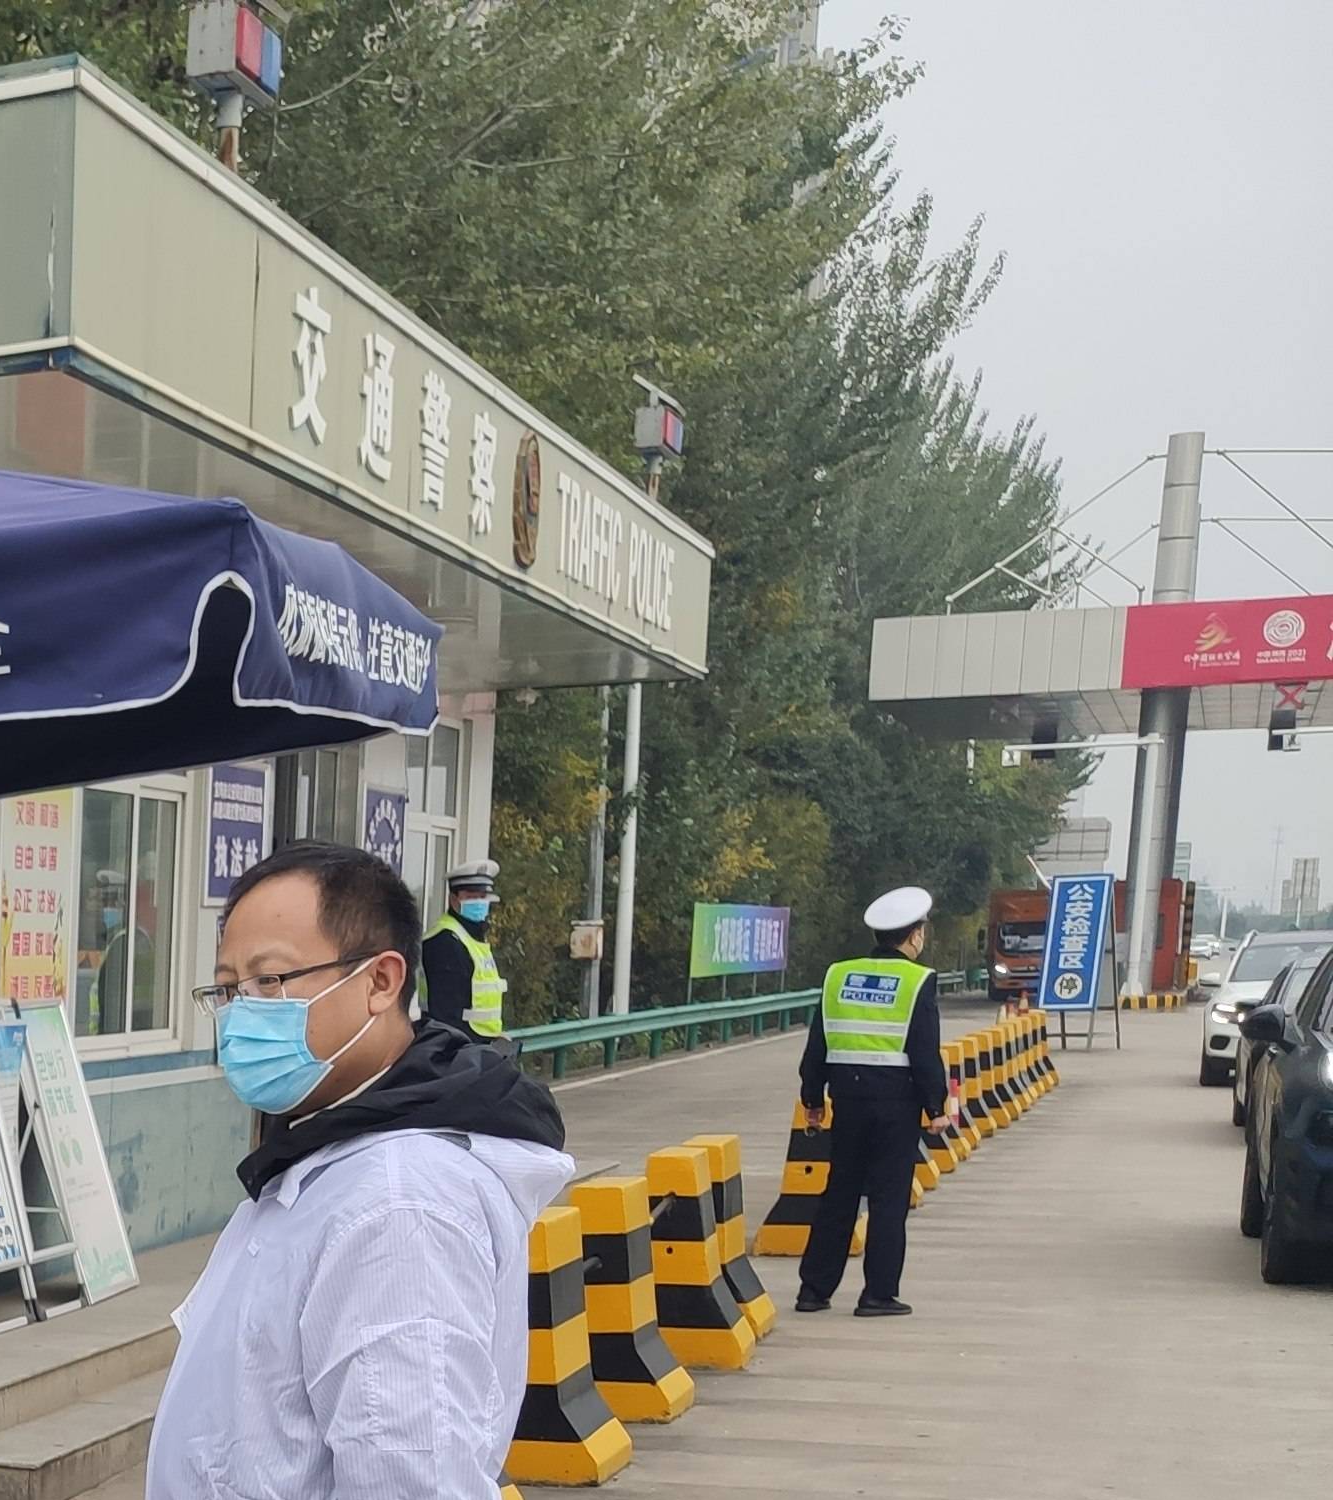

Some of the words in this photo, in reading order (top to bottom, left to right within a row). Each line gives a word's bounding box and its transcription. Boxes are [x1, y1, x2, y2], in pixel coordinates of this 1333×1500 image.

[290, 287, 497, 533] 交通警察
[558, 472, 623, 602] TRAFFIC
[627, 521, 675, 631] POLICE
[1058, 883, 1096, 969] 公安检查区
[842, 990, 894, 1004] POLICE
[1059, 975, 1079, 996] 停
